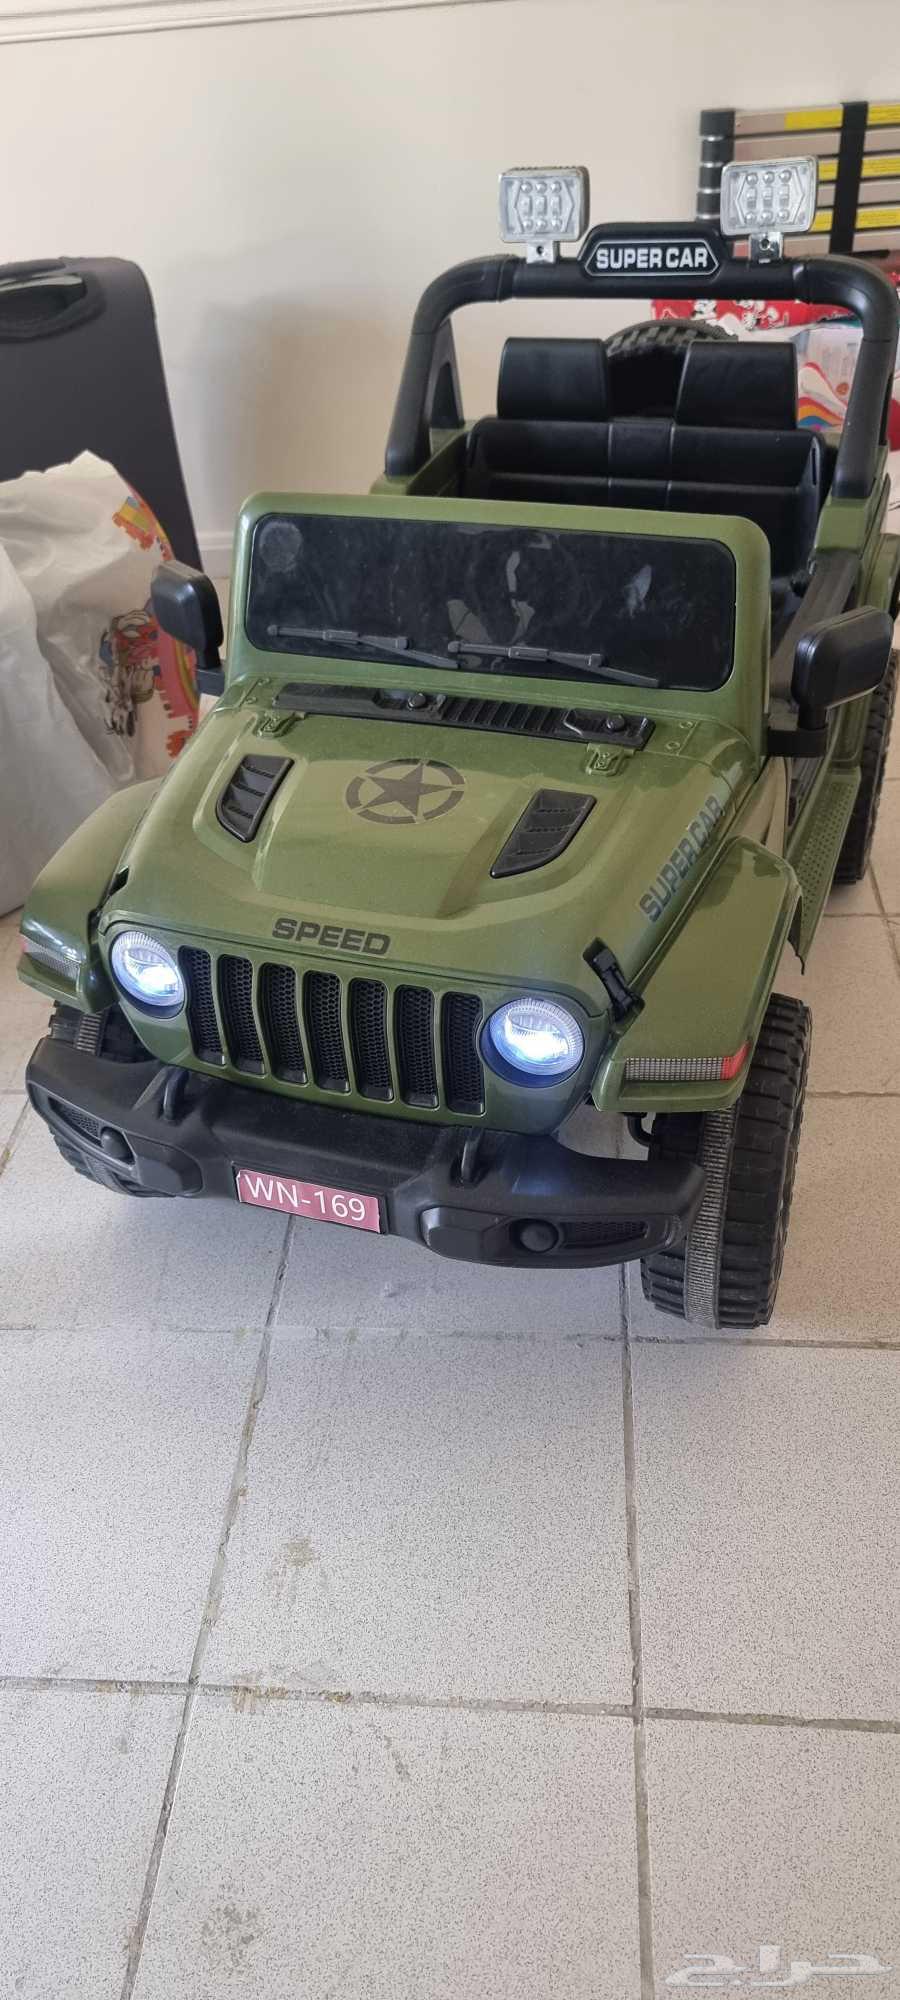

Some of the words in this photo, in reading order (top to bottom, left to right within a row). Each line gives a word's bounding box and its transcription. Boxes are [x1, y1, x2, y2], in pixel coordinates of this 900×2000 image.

[596, 247, 664, 270] SUPER
[665, 245, 709, 268] CAR
[639, 837, 697, 923] SUPER
[687, 795, 726, 850] CAR
[271, 917, 391, 955] SPEED
[244, 1174, 366, 1222] WN-169
